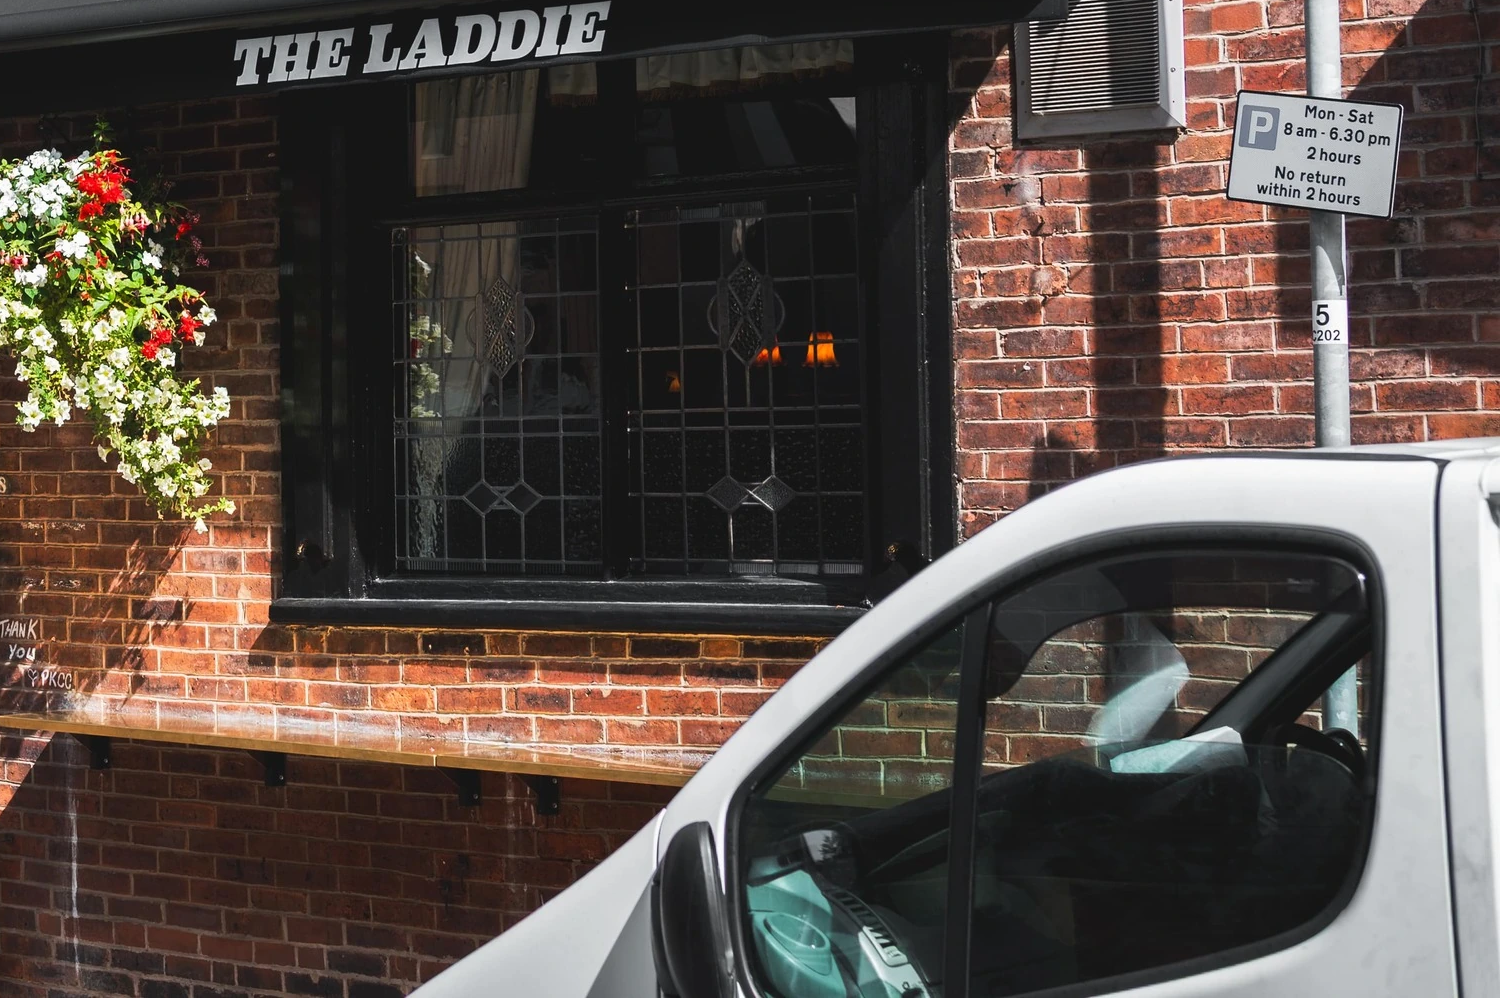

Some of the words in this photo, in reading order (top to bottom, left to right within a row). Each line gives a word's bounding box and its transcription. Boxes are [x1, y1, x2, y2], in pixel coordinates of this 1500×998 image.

[233, 27, 355, 86] THE
[362, 0, 612, 74] LADDIE
[1304, 104, 1335, 121] Mon
[1347, 109, 1374, 124] Sat
[1248, 110, 1274, 144] P
[1284, 122, 1293, 135] 8
[1296, 127, 1317, 138] am
[1329, 127, 1365, 143] 6.30
[1368, 133, 1391, 146] pm
[1307, 146, 1316, 160] 2
[1320, 148, 1361, 165] hours
[1274, 165, 1295, 181] No
[1300, 170, 1346, 186] return
[1257, 183, 1301, 199] within
[1306, 187, 1316, 201] 2
[1319, 188, 1360, 206] hours
[1316, 304, 1330, 326] 5
[9, 644, 36, 661] YOU
